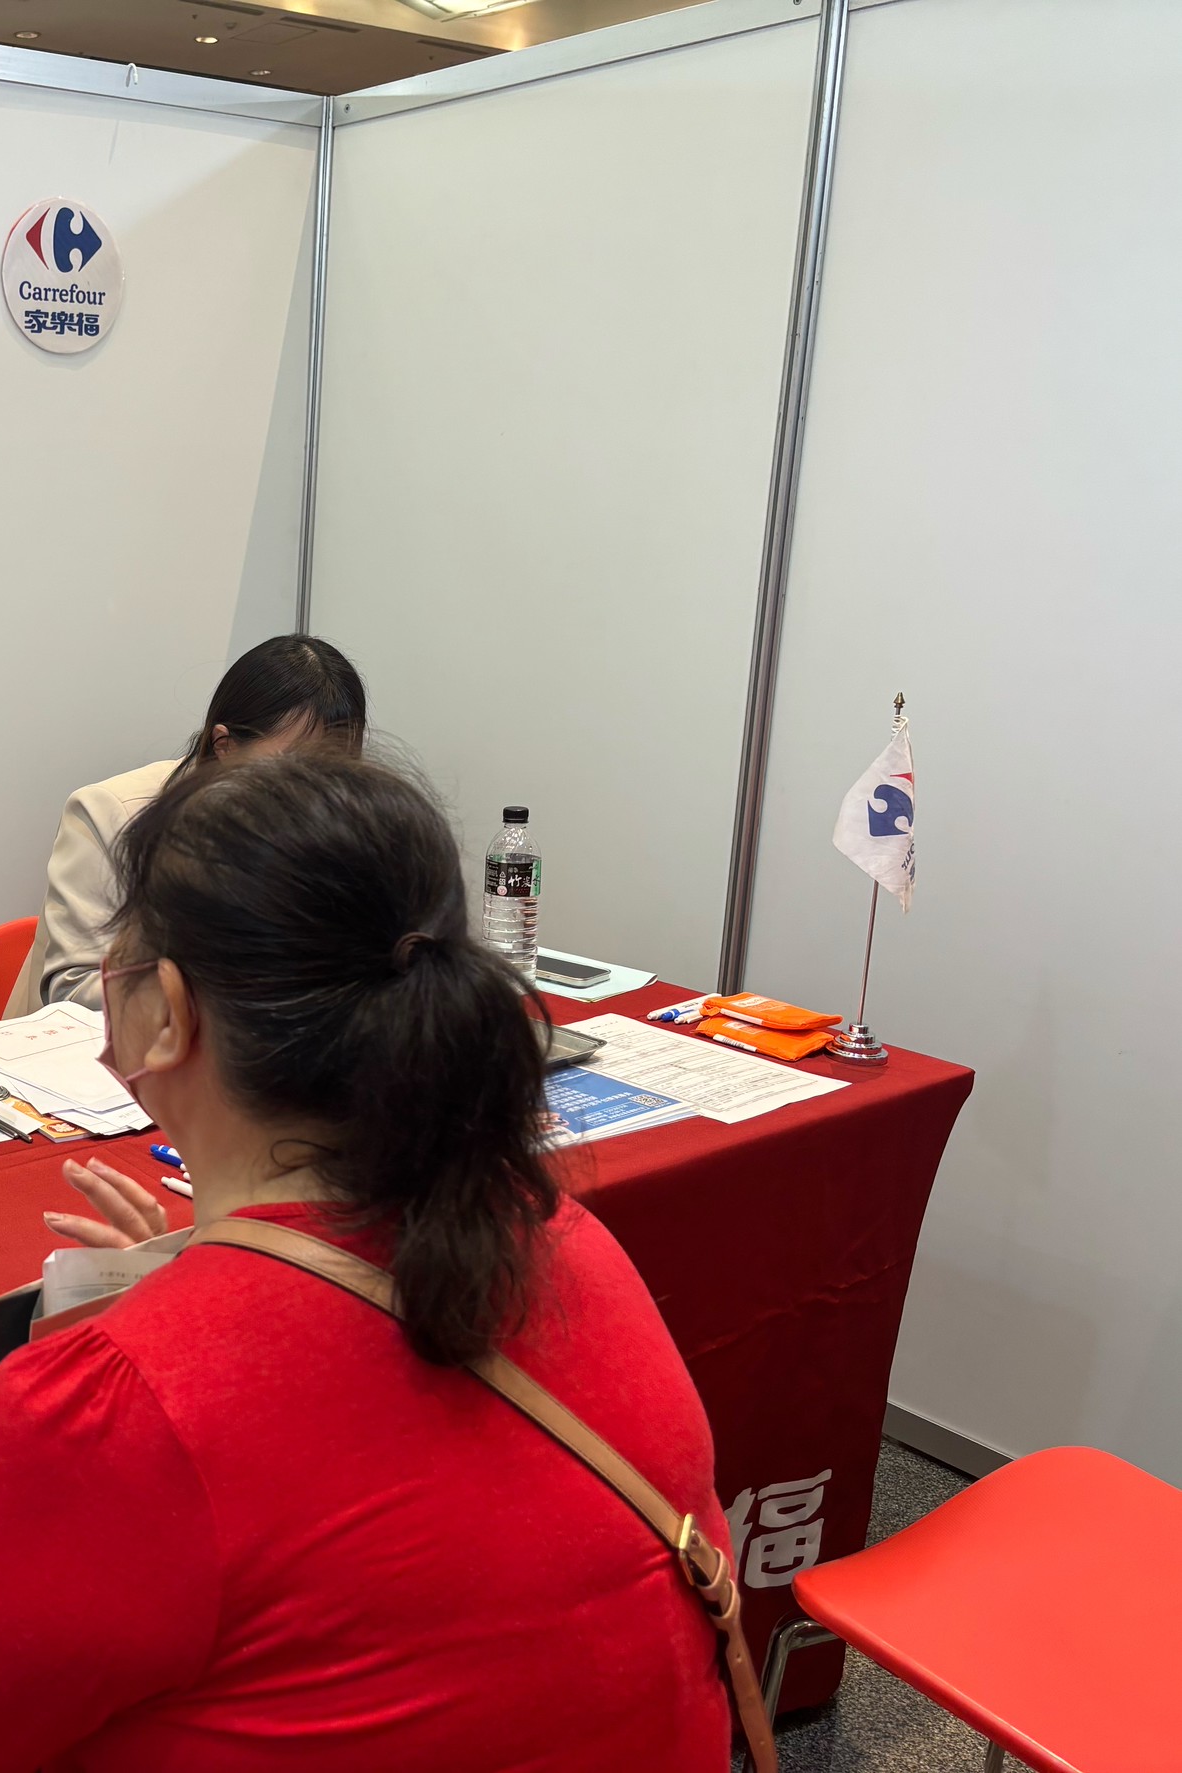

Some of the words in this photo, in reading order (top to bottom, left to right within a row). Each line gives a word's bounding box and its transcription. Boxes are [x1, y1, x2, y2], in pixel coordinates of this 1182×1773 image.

[19, 281, 106, 305] Carrefour
[24, 309, 100, 336] 家樂福
